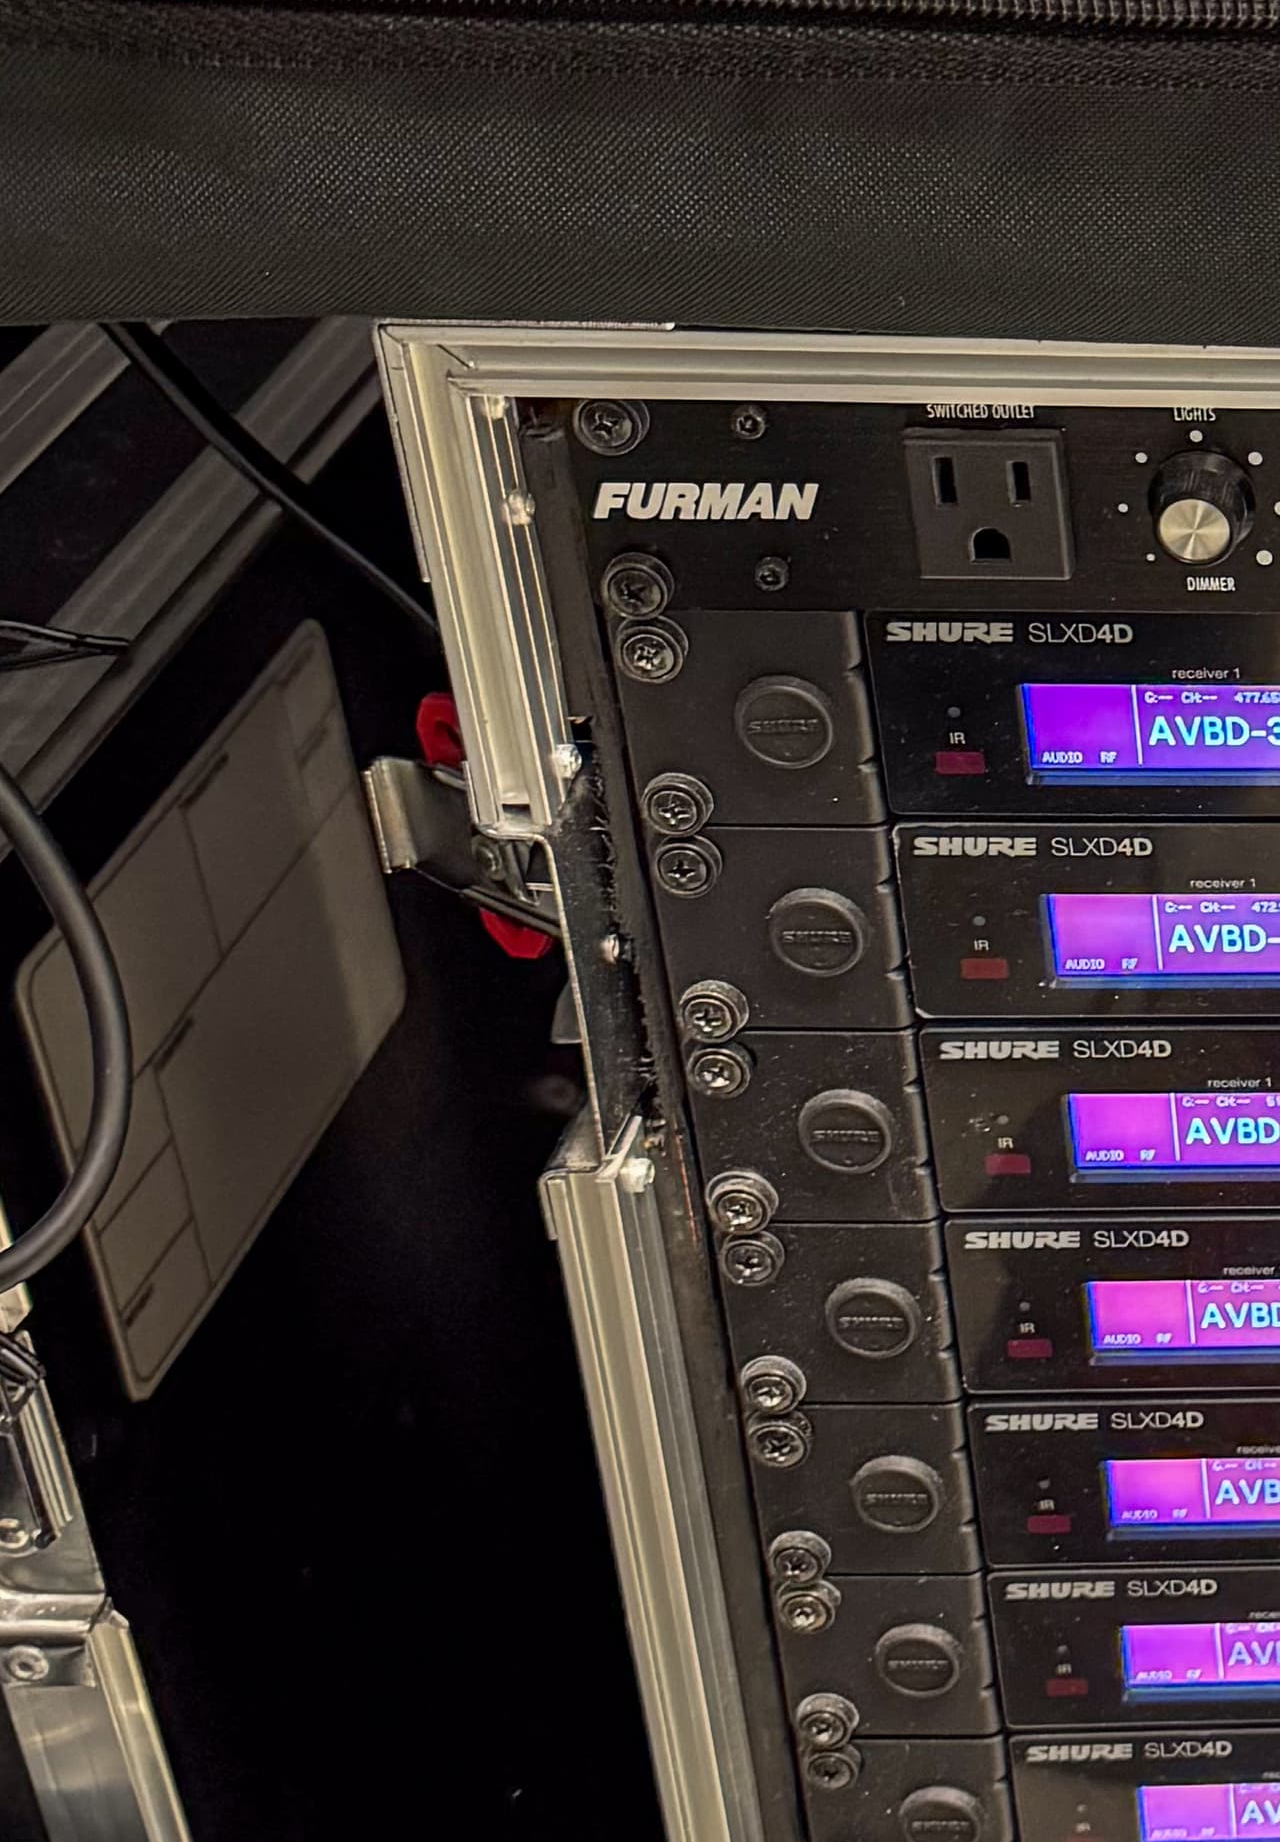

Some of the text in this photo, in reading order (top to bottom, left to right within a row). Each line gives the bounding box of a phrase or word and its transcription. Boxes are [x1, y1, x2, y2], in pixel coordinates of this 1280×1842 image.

[926, 404, 989, 419] SWITCHED
[1173, 407, 1217, 422] LIGHTS
[593, 482, 819, 520] FURMAN
[1185, 576, 1236, 591] DIMMER
[885, 621, 1133, 644] SHURE SLXD4D
[1171, 667, 1241, 680] receiver 1
[949, 731, 966, 744] IR
[1042, 750, 1084, 765] AUDIO
[913, 837, 1152, 856] SHURE SLXD4D
[940, 1040, 1171, 1059] SHURE SLXD4D
[965, 1230, 1189, 1249] SHURE SLXD4D
[984, 1411, 1204, 1431] SHURE SLXD4D
[1005, 1579, 1217, 1600] SHURE SLXD4D
[1026, 1743, 1133, 1761] SHURE
